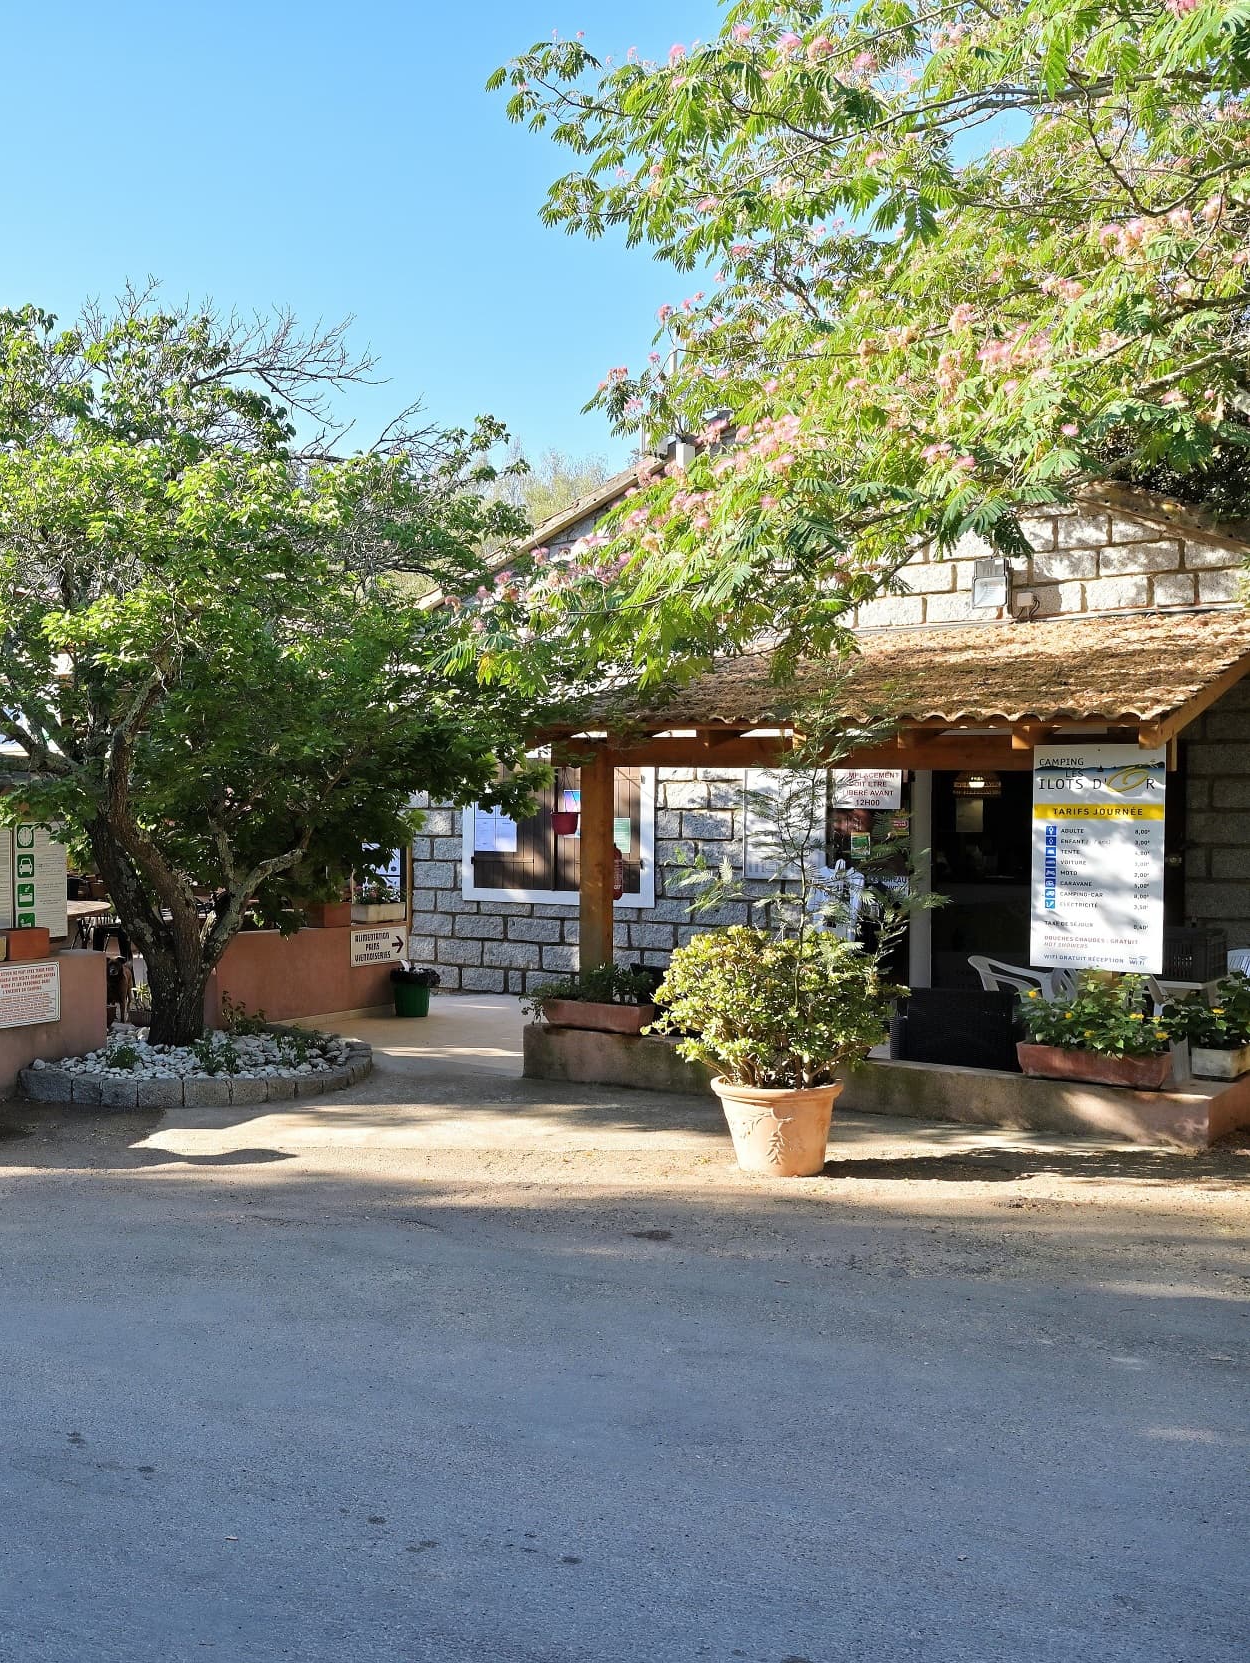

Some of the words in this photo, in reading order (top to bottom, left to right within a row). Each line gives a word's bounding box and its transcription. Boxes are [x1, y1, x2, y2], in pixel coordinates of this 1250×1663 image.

[1039, 758, 1084, 766] CAMPING
[845, 771, 899, 779] MPLACEMENT
[1065, 770, 1084, 778] LES
[1039, 778, 1084, 790] ILOTS
[1053, 808, 1090, 816] TARIFS
[1093, 806, 1143, 816] JOURNÉE
[1059, 954, 1086, 962] GRATUIT
